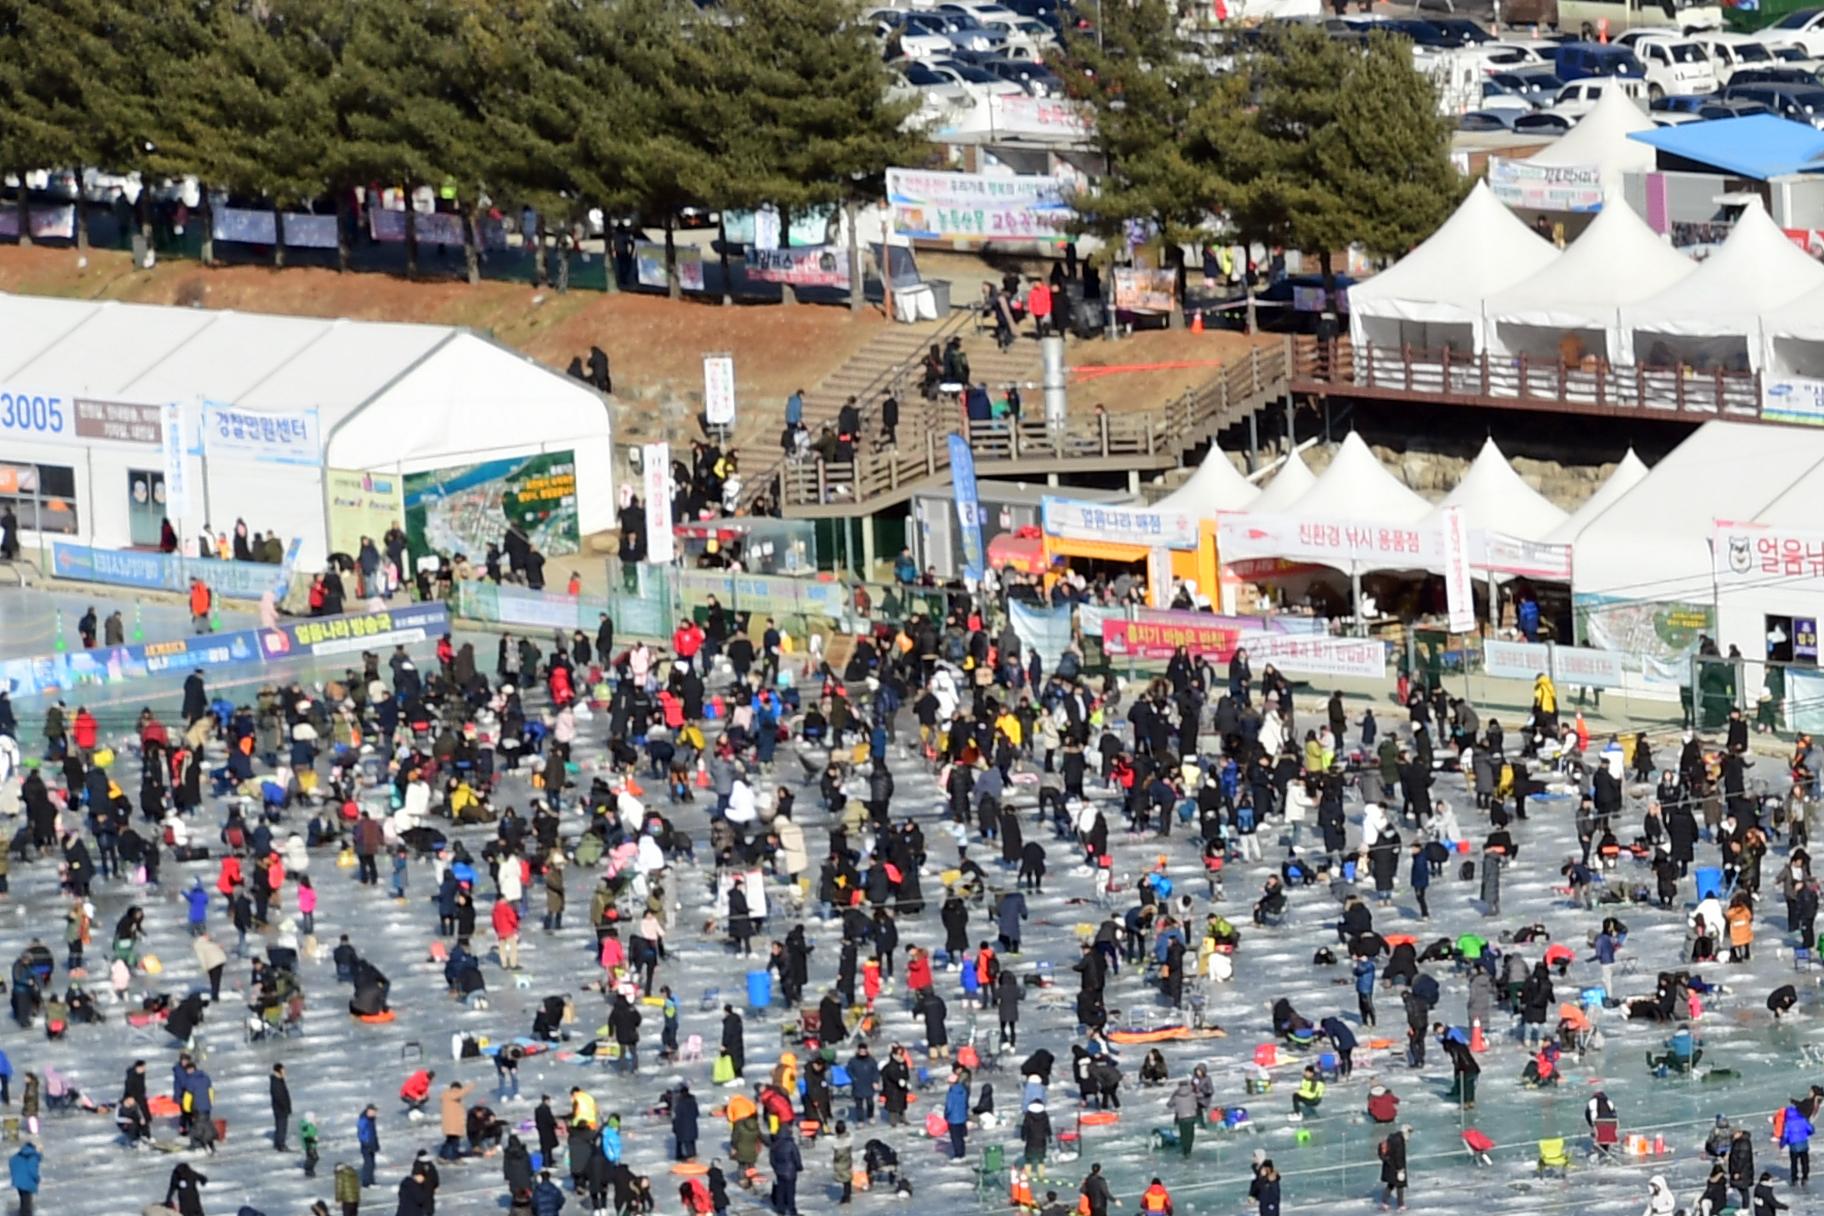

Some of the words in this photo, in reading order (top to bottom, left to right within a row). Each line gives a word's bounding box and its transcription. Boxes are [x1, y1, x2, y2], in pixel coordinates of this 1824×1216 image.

[1, 392, 63, 433] 3005
[1300, 522, 1341, 548] 친환경
[1346, 526, 1374, 550] 낚시
